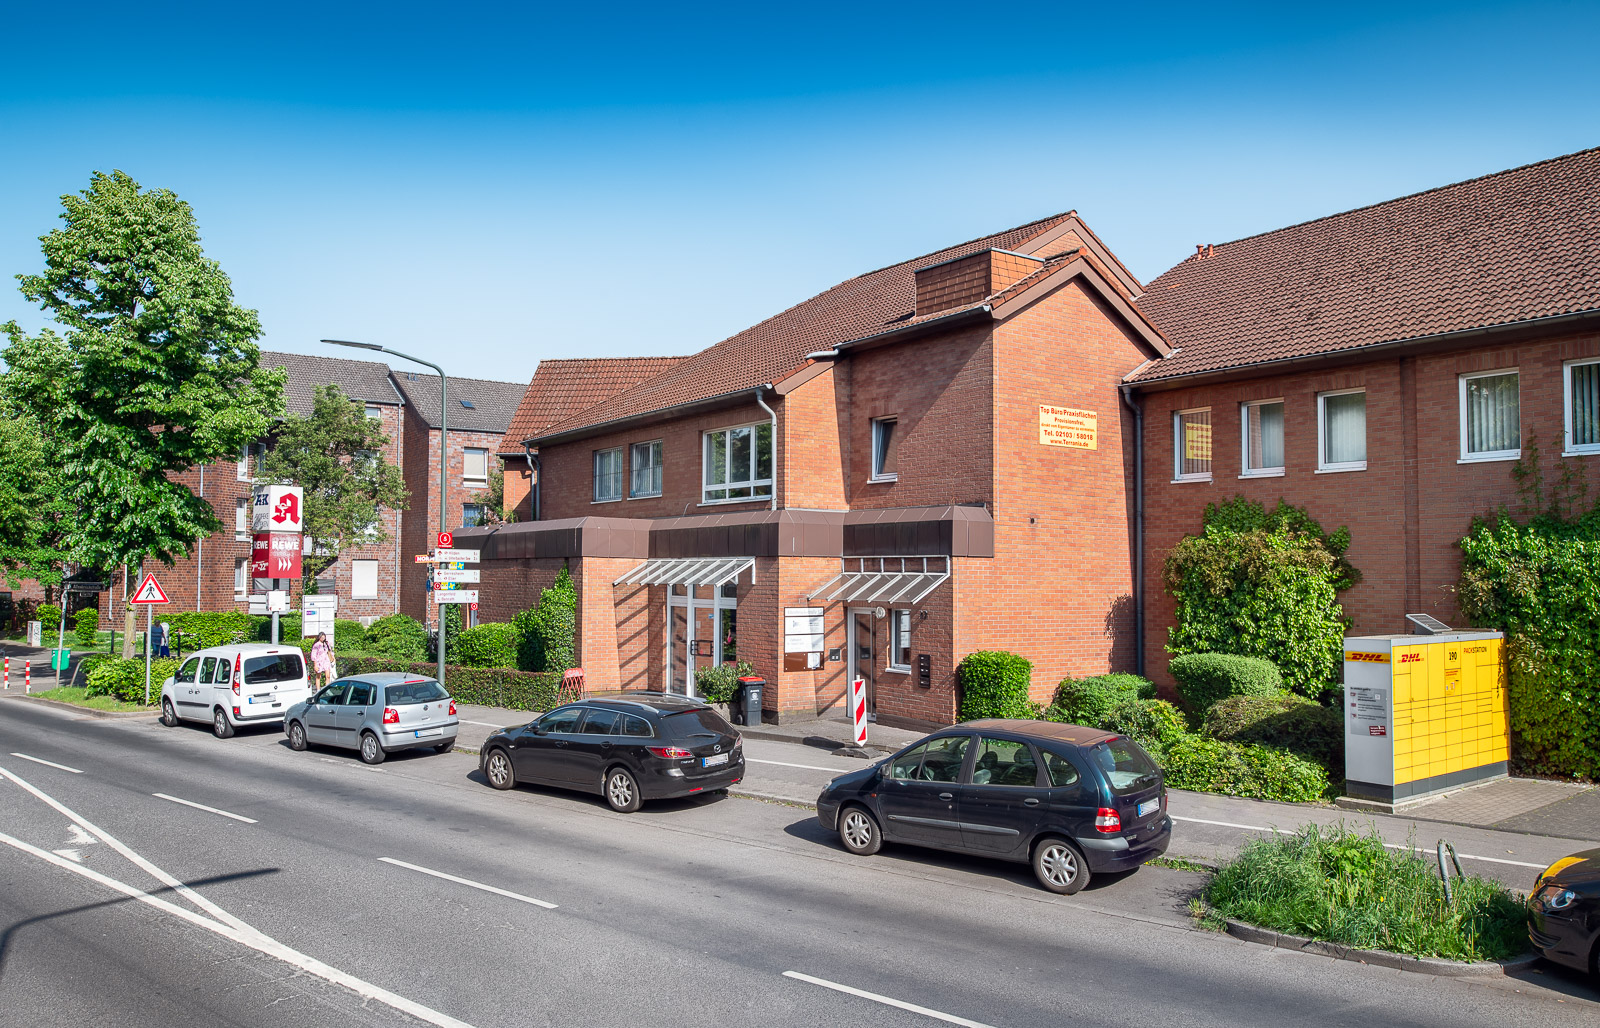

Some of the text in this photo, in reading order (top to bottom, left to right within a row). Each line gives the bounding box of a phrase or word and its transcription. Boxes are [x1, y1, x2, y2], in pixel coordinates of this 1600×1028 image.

[254, 540, 268, 550] REWE
[272, 541, 299, 550] REWE
[1463, 646, 1488, 654] PACKSTATION
[1351, 653, 1384, 662] DHL
[1401, 653, 1421, 663] DHL
[1448, 651, 1458, 661] 190
